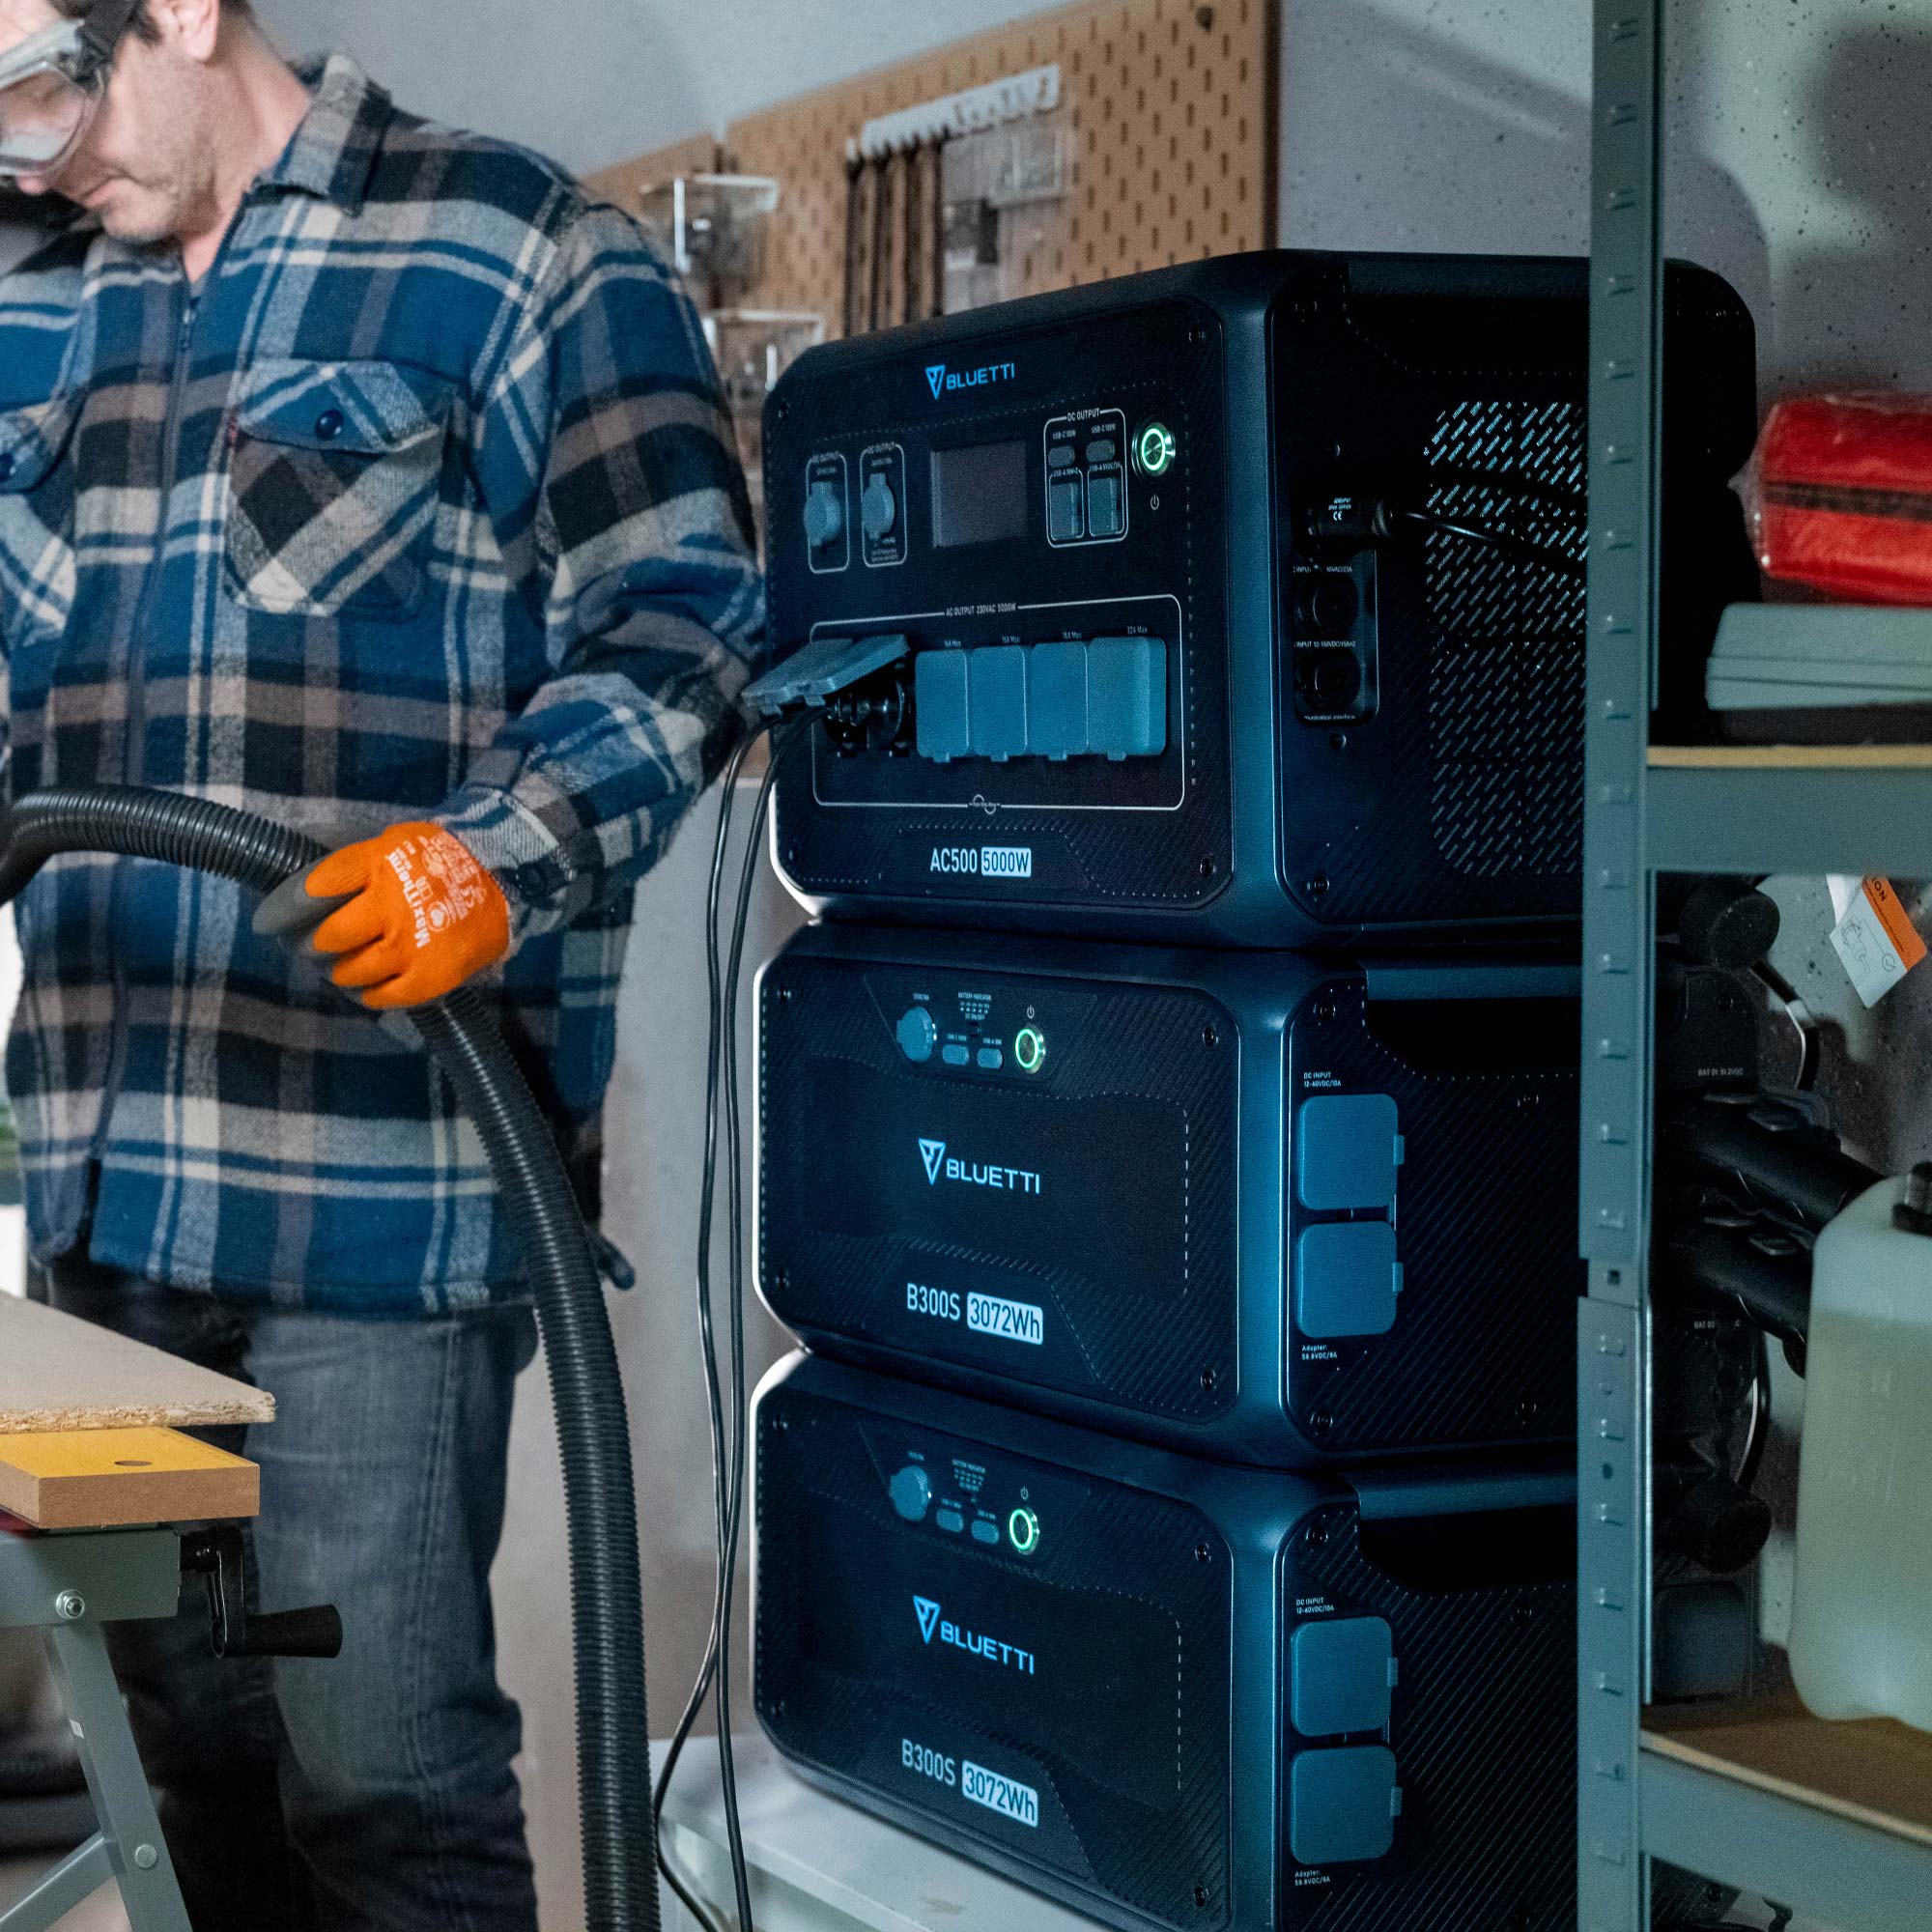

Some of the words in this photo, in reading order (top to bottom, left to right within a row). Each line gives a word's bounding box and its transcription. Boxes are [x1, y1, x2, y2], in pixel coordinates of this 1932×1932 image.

[947, 362, 1015, 390] BLUETTI
[1066, 412, 1076, 422] DC
[1076, 407, 1100, 421] OUTPUT
[946, 607, 953, 616] AC
[953, 605, 975, 616] OUTPUT
[929, 847, 978, 873] AC500
[982, 850, 1030, 873] 5000W
[1313, 1070, 1331, 1079] INPUT
[946, 1158, 1040, 1195] BLUETTI
[906, 1282, 961, 1321] B300S
[969, 1296, 1041, 1341] 3072Wh
[1295, 1598, 1305, 1606] DC
[1305, 1596, 1324, 1605] INPUT
[940, 1620, 1035, 1675] BLUETTI
[902, 1739, 956, 1786] B300S
[965, 1767, 1037, 1823] 3072Wh
